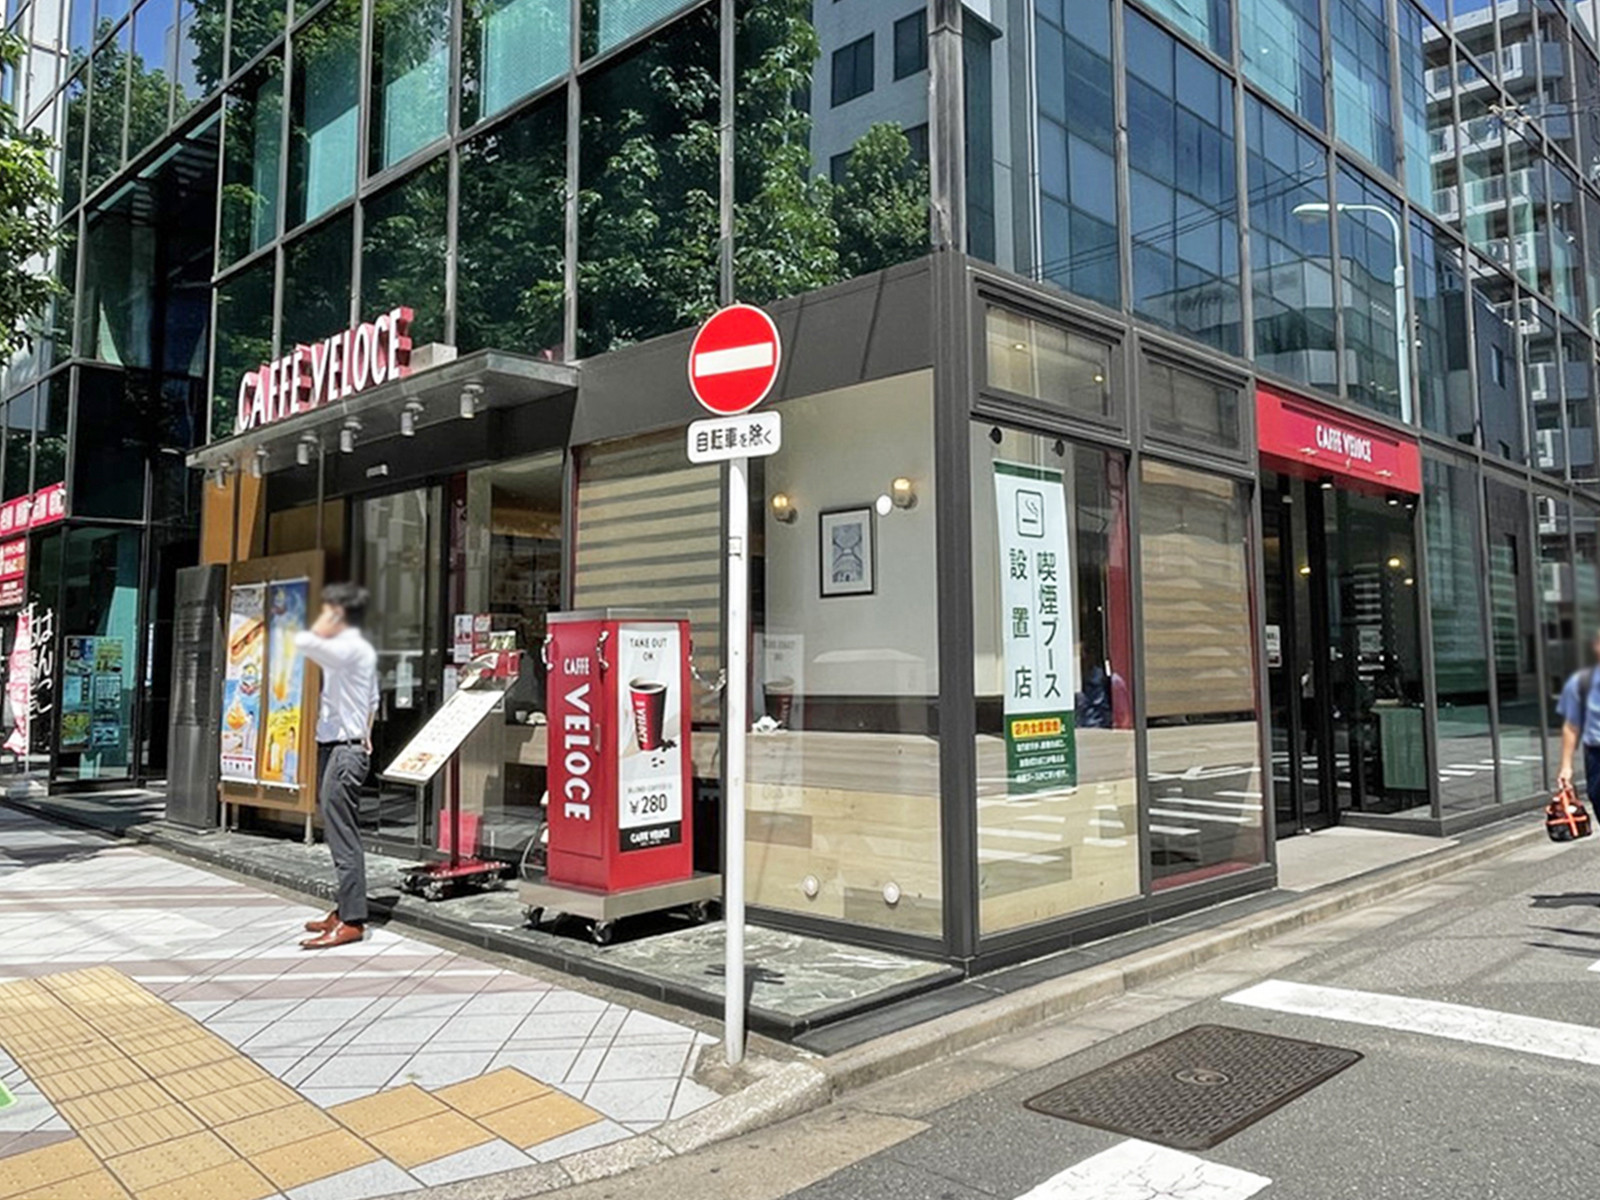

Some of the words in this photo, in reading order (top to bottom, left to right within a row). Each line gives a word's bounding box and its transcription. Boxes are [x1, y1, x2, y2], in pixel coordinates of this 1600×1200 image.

[311, 306, 413, 405] VELOCE
[696, 423, 772, 453] 自転車を除く
[630, 637, 650, 649] TAKE
[651, 636, 668, 649] OUT
[1010, 548, 1032, 699] 設置店
[1036, 551, 1061, 699] 喫煙ブース
[564, 683, 591, 821] VELOCE
[629, 793, 668, 815] ¥280
